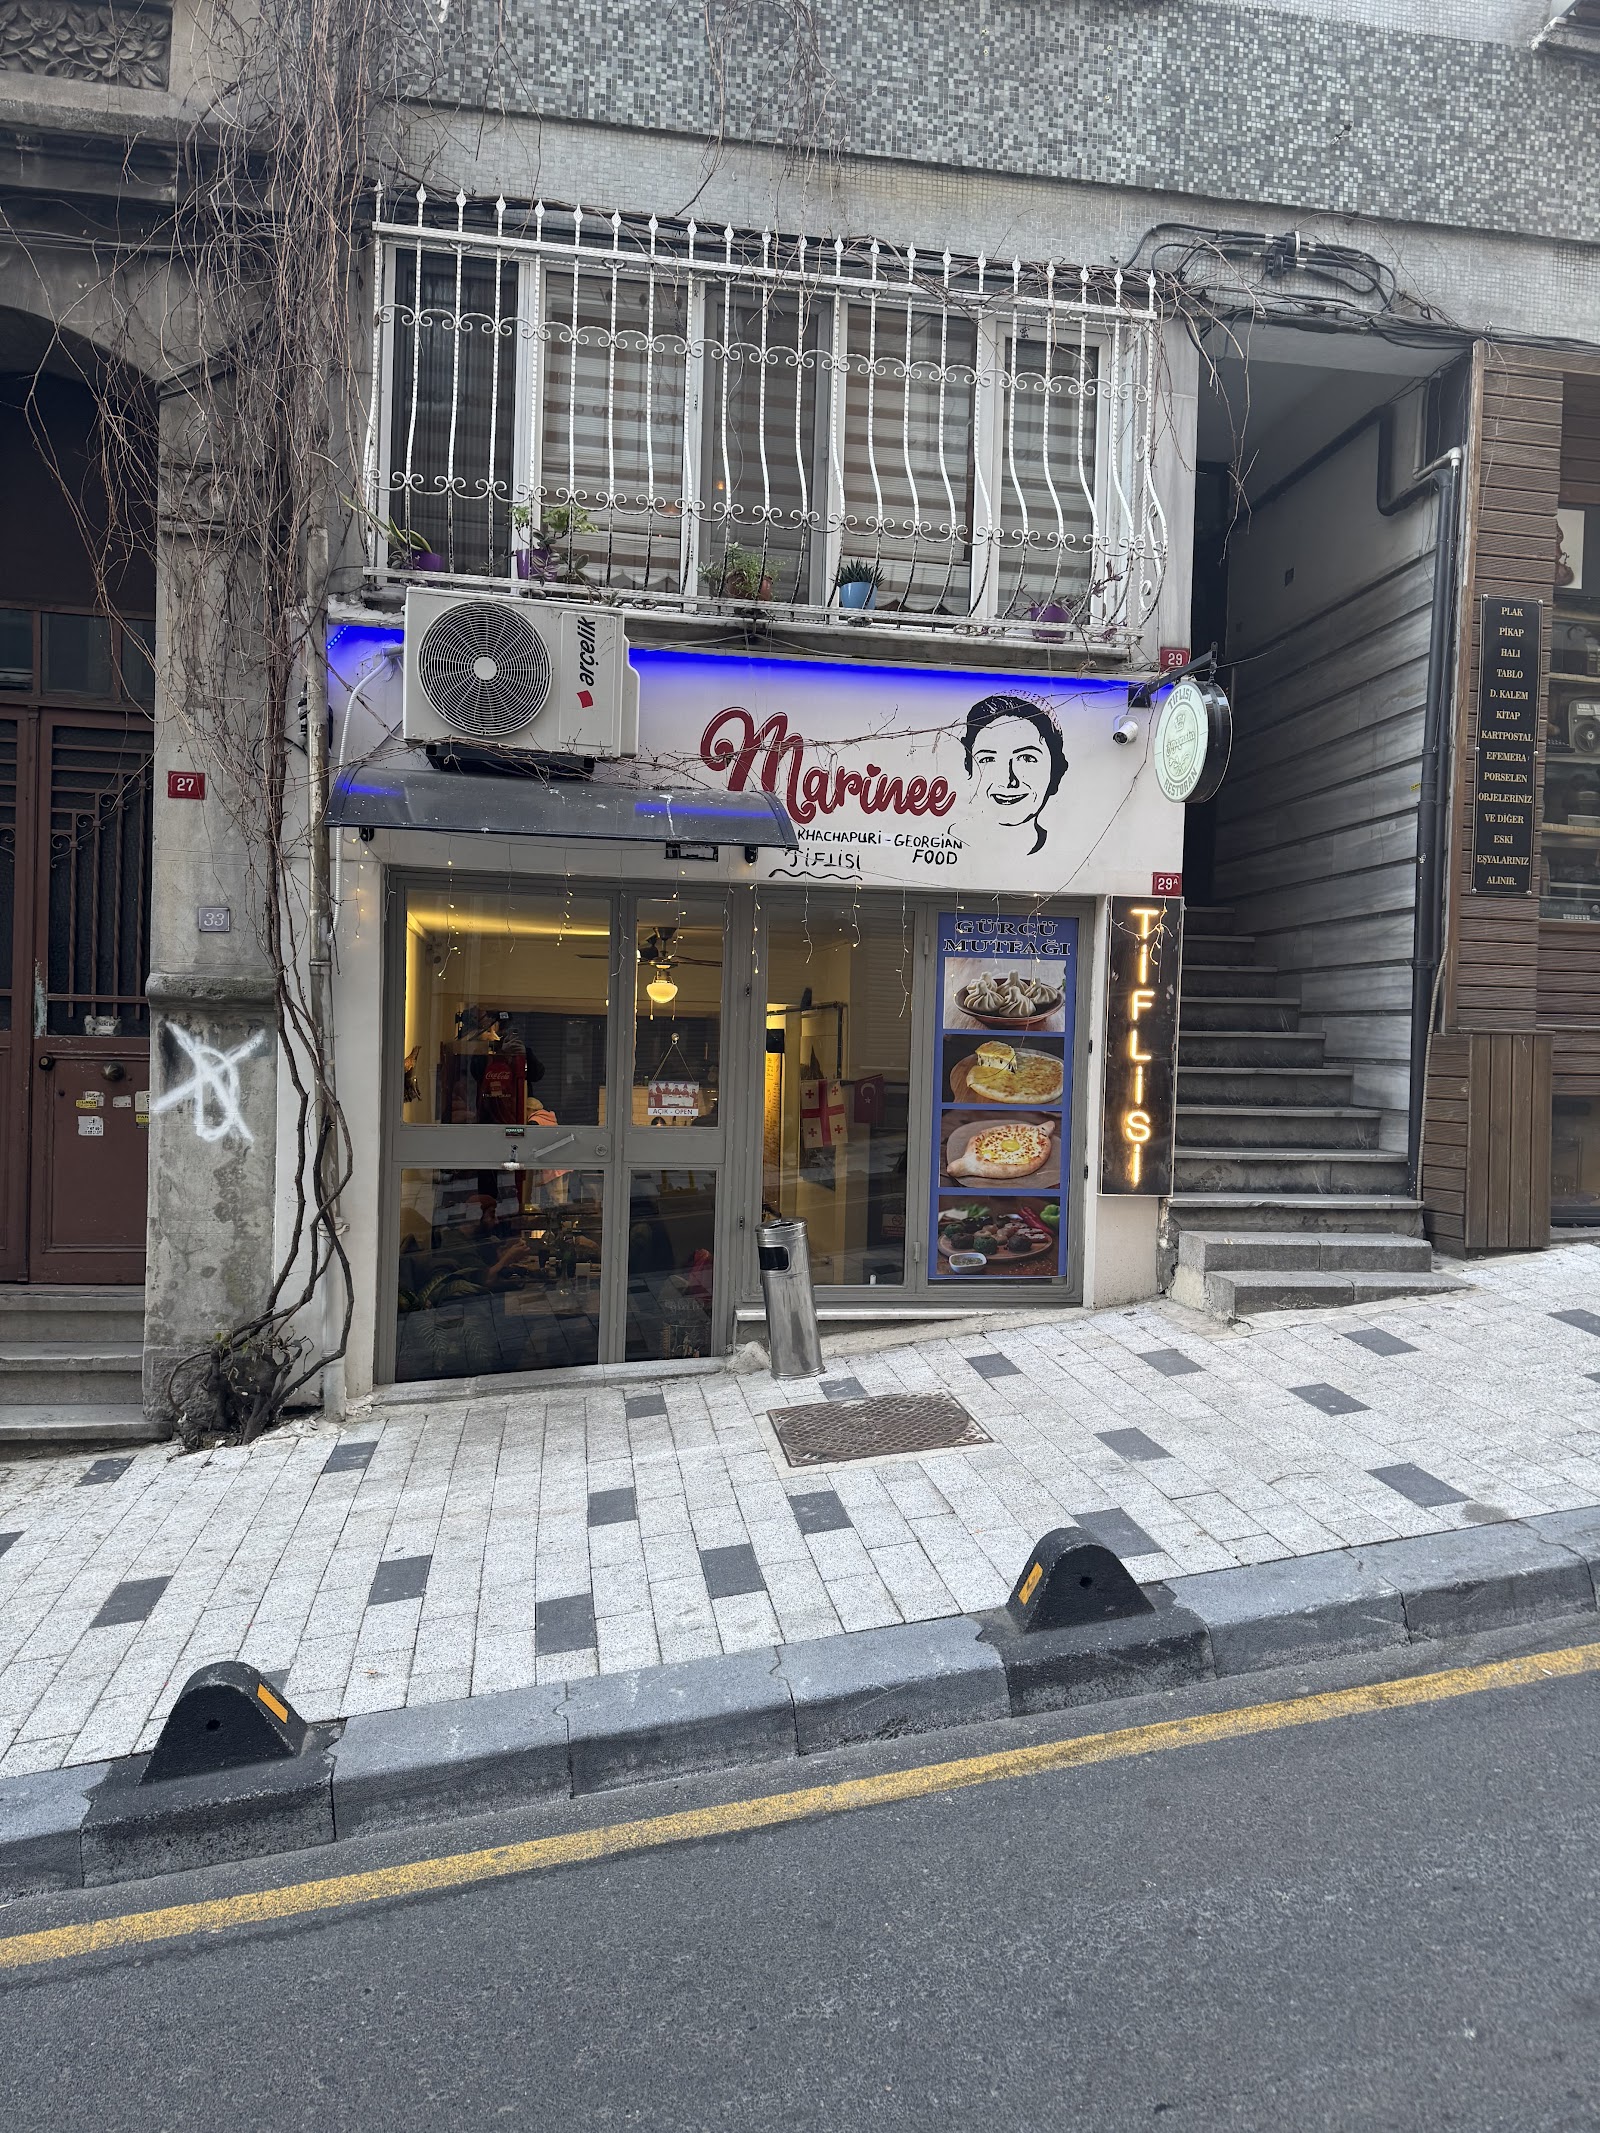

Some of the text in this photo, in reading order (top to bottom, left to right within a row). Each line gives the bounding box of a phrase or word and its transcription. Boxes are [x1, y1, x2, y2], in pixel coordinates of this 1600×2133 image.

[1501, 607, 1523, 616] PLAK
[1499, 626, 1524, 637] PİKAP
[577, 616, 599, 686] arçelik
[1501, 649, 1521, 658] HALI
[1168, 653, 1183, 665] 29
[1497, 669, 1524, 679] TABLO
[1490, 689, 1529, 700] D. KALEM
[1496, 709, 1521, 720] KİTAP
[1481, 731, 1533, 742] KARTPOSTAL
[1486, 752, 1526, 762] EFEMERA
[700, 706, 957, 824] Marinee
[1163, 766, 1198, 797] RESTORAN
[1484, 772, 1528, 783] PORSELEN
[177, 778, 194, 792] 27
[1478, 792, 1533, 804] OBJELERİNİZ
[1485, 813, 1524, 824] VE DİĞER
[1494, 834, 1514, 845] ESKİ
[912, 849, 958, 866] FOOD
[1477, 855, 1530, 866] EŞYALARINIZ
[1487, 876, 1517, 886] ALINIR.
[204, 912, 225, 927] 33
[955, 919, 1059, 936] GÜRCÜ
[943, 939, 1071, 955] MUTFAĞI
